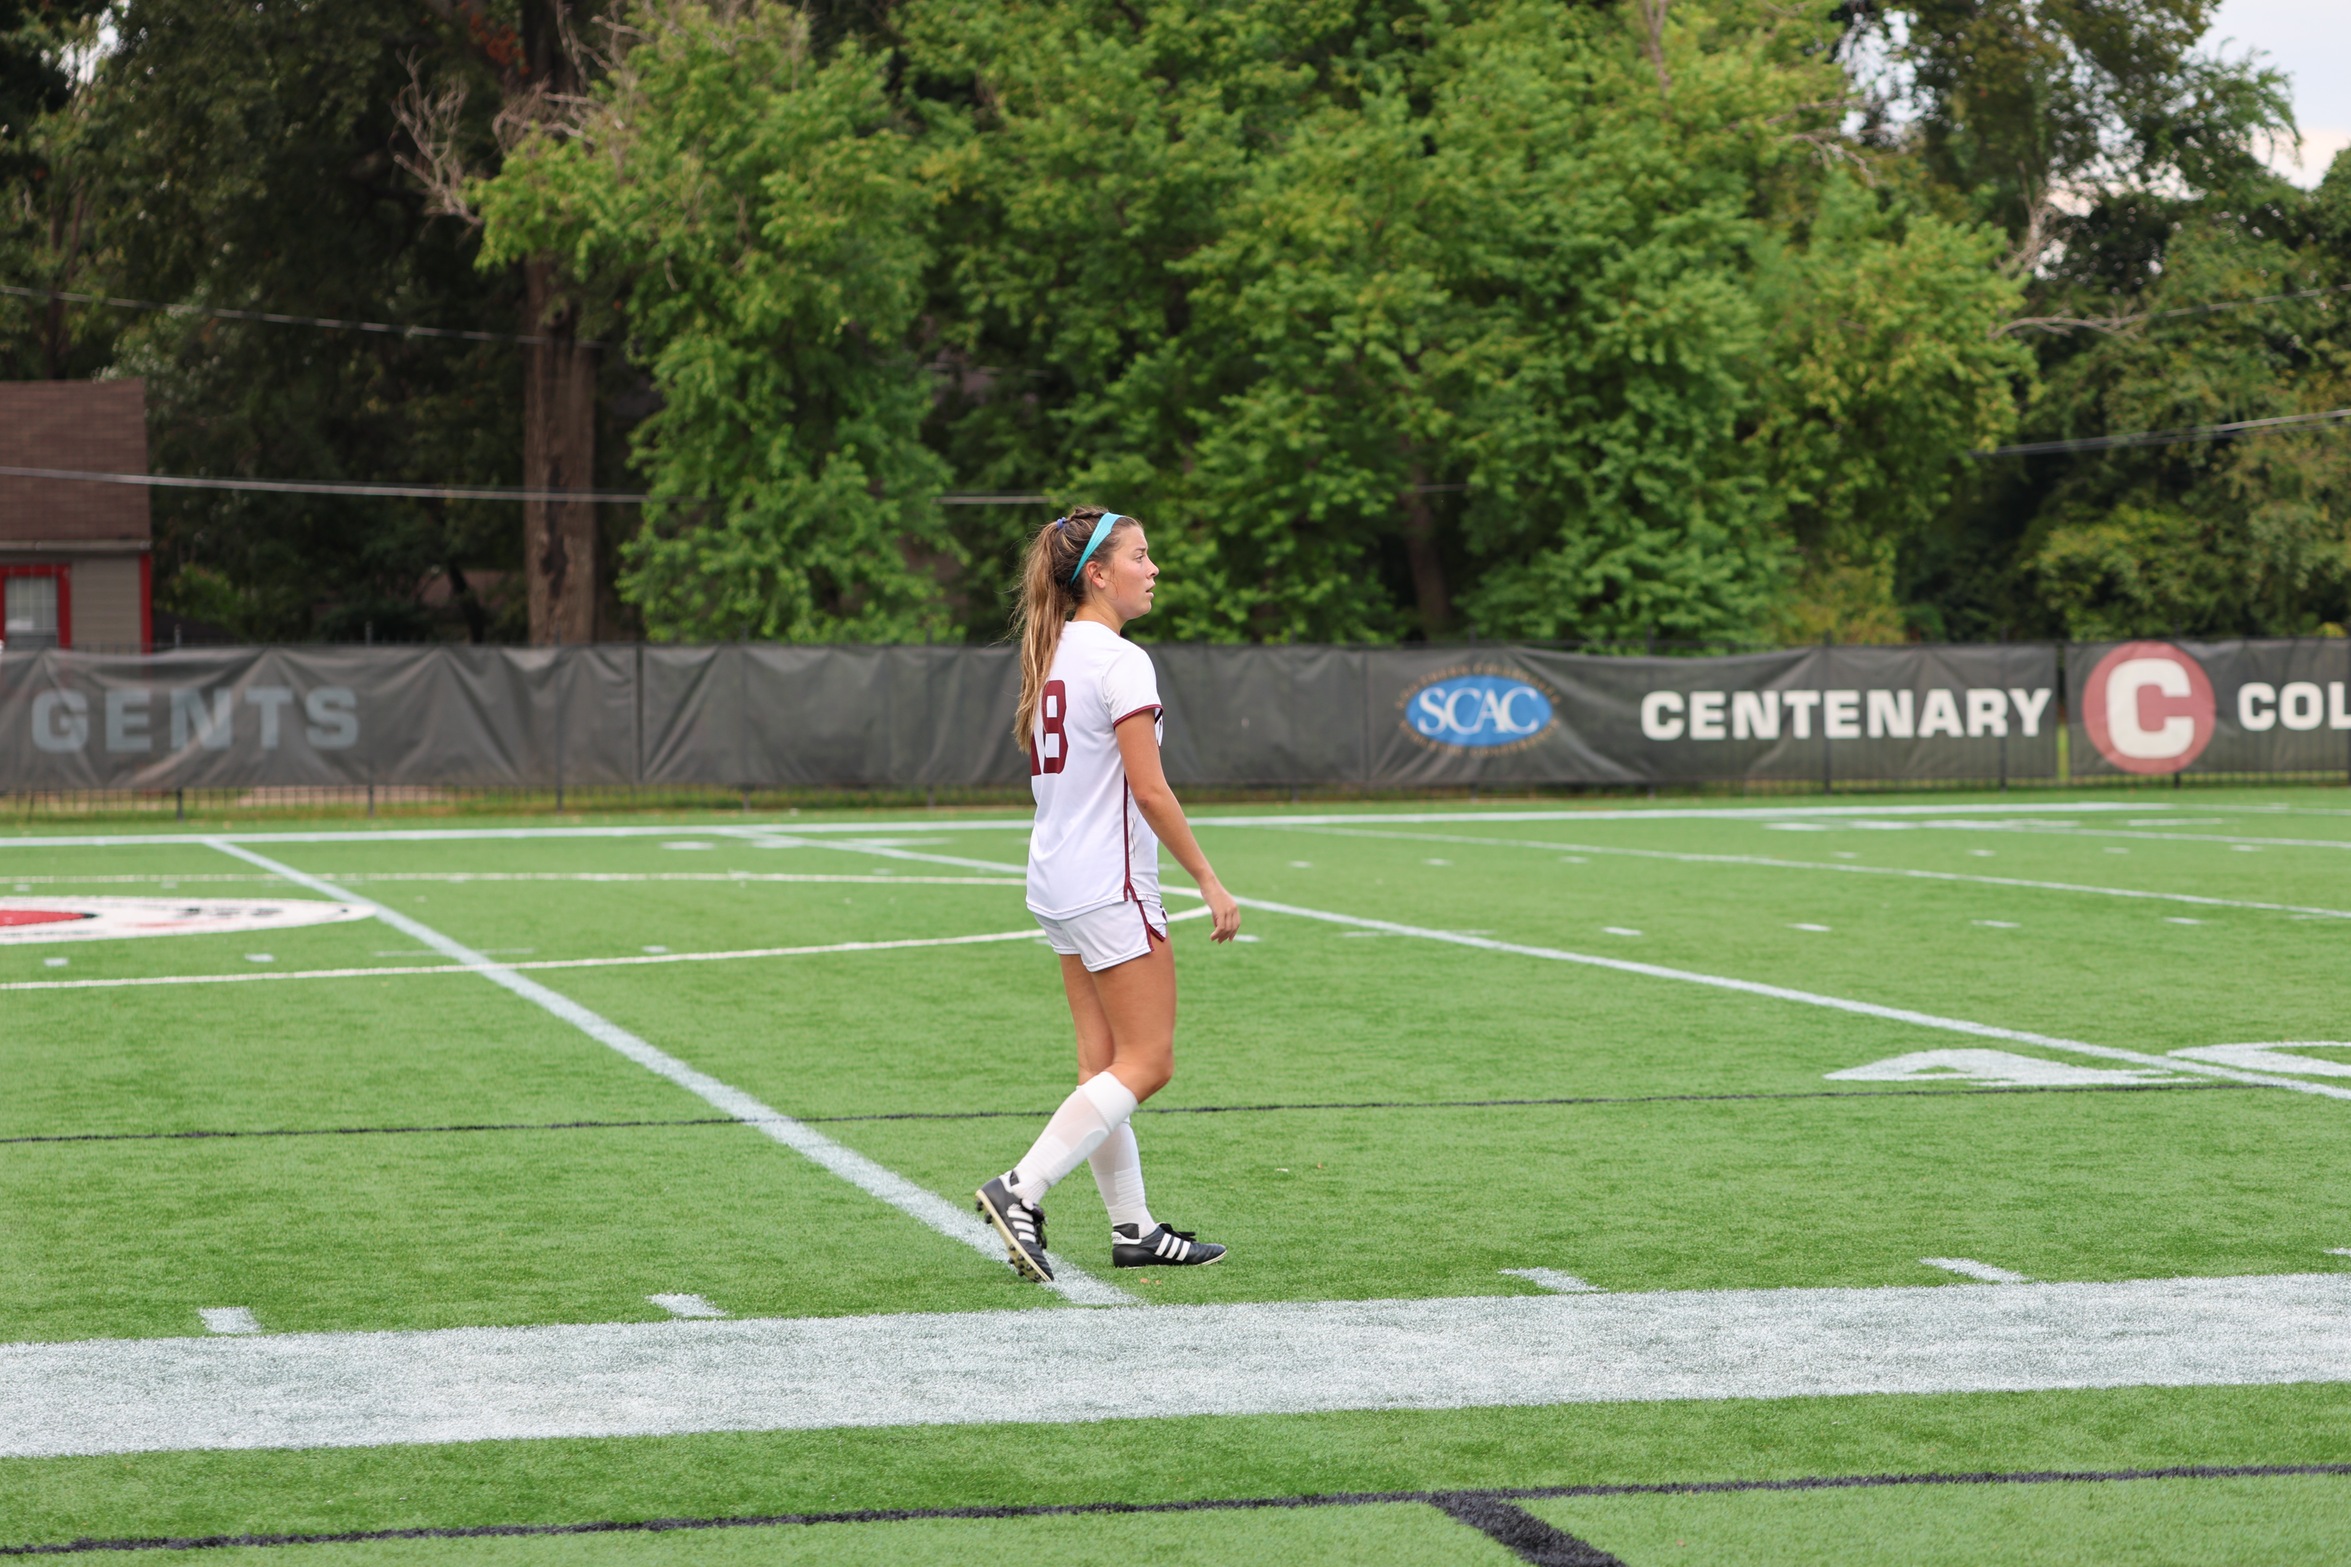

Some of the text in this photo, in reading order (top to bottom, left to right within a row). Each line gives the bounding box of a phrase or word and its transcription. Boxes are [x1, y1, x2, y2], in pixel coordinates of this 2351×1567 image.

[31, 688, 359, 751] GENTS
[1417, 686, 1540, 735] SCAC
[1641, 688, 2052, 740] CENTENARY
[2105, 658, 2195, 759] C
[2237, 681, 2351, 731] COL
